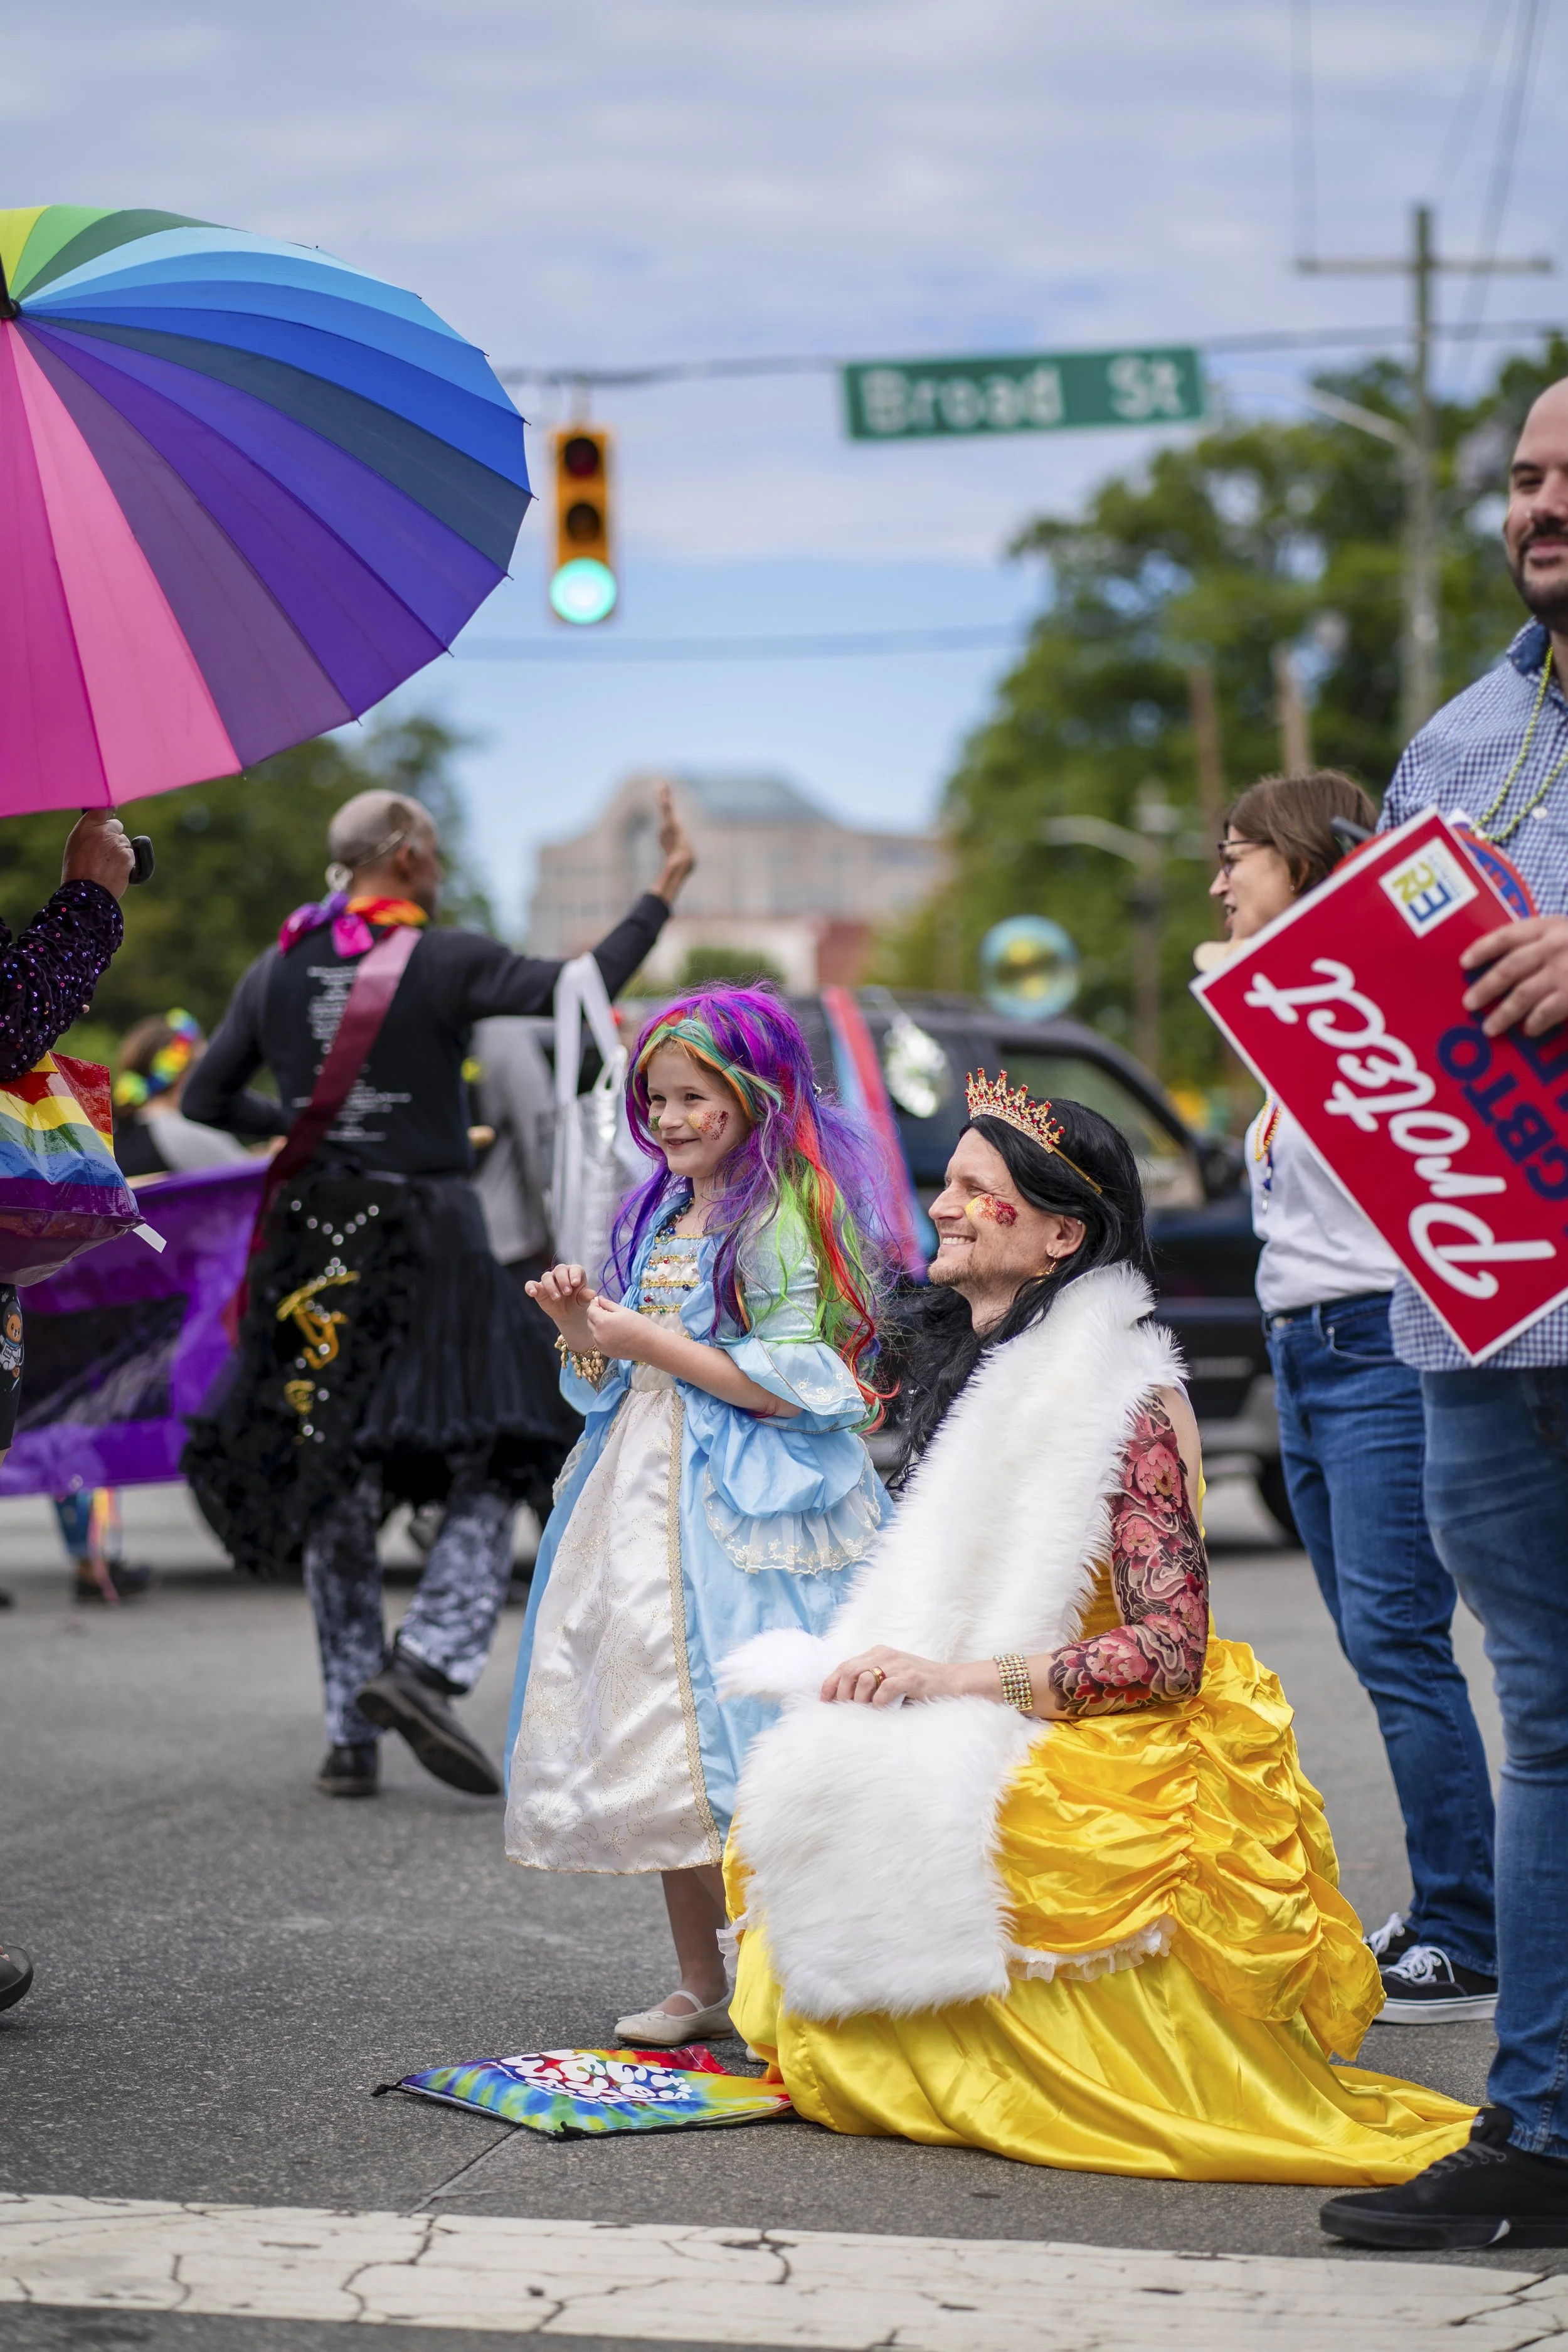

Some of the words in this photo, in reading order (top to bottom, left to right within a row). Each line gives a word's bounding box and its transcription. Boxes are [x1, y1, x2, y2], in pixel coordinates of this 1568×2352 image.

[859, 363, 1062, 433] Broad
[1106, 355, 1186, 420] St
[1245, 958, 1555, 1298] Protect
